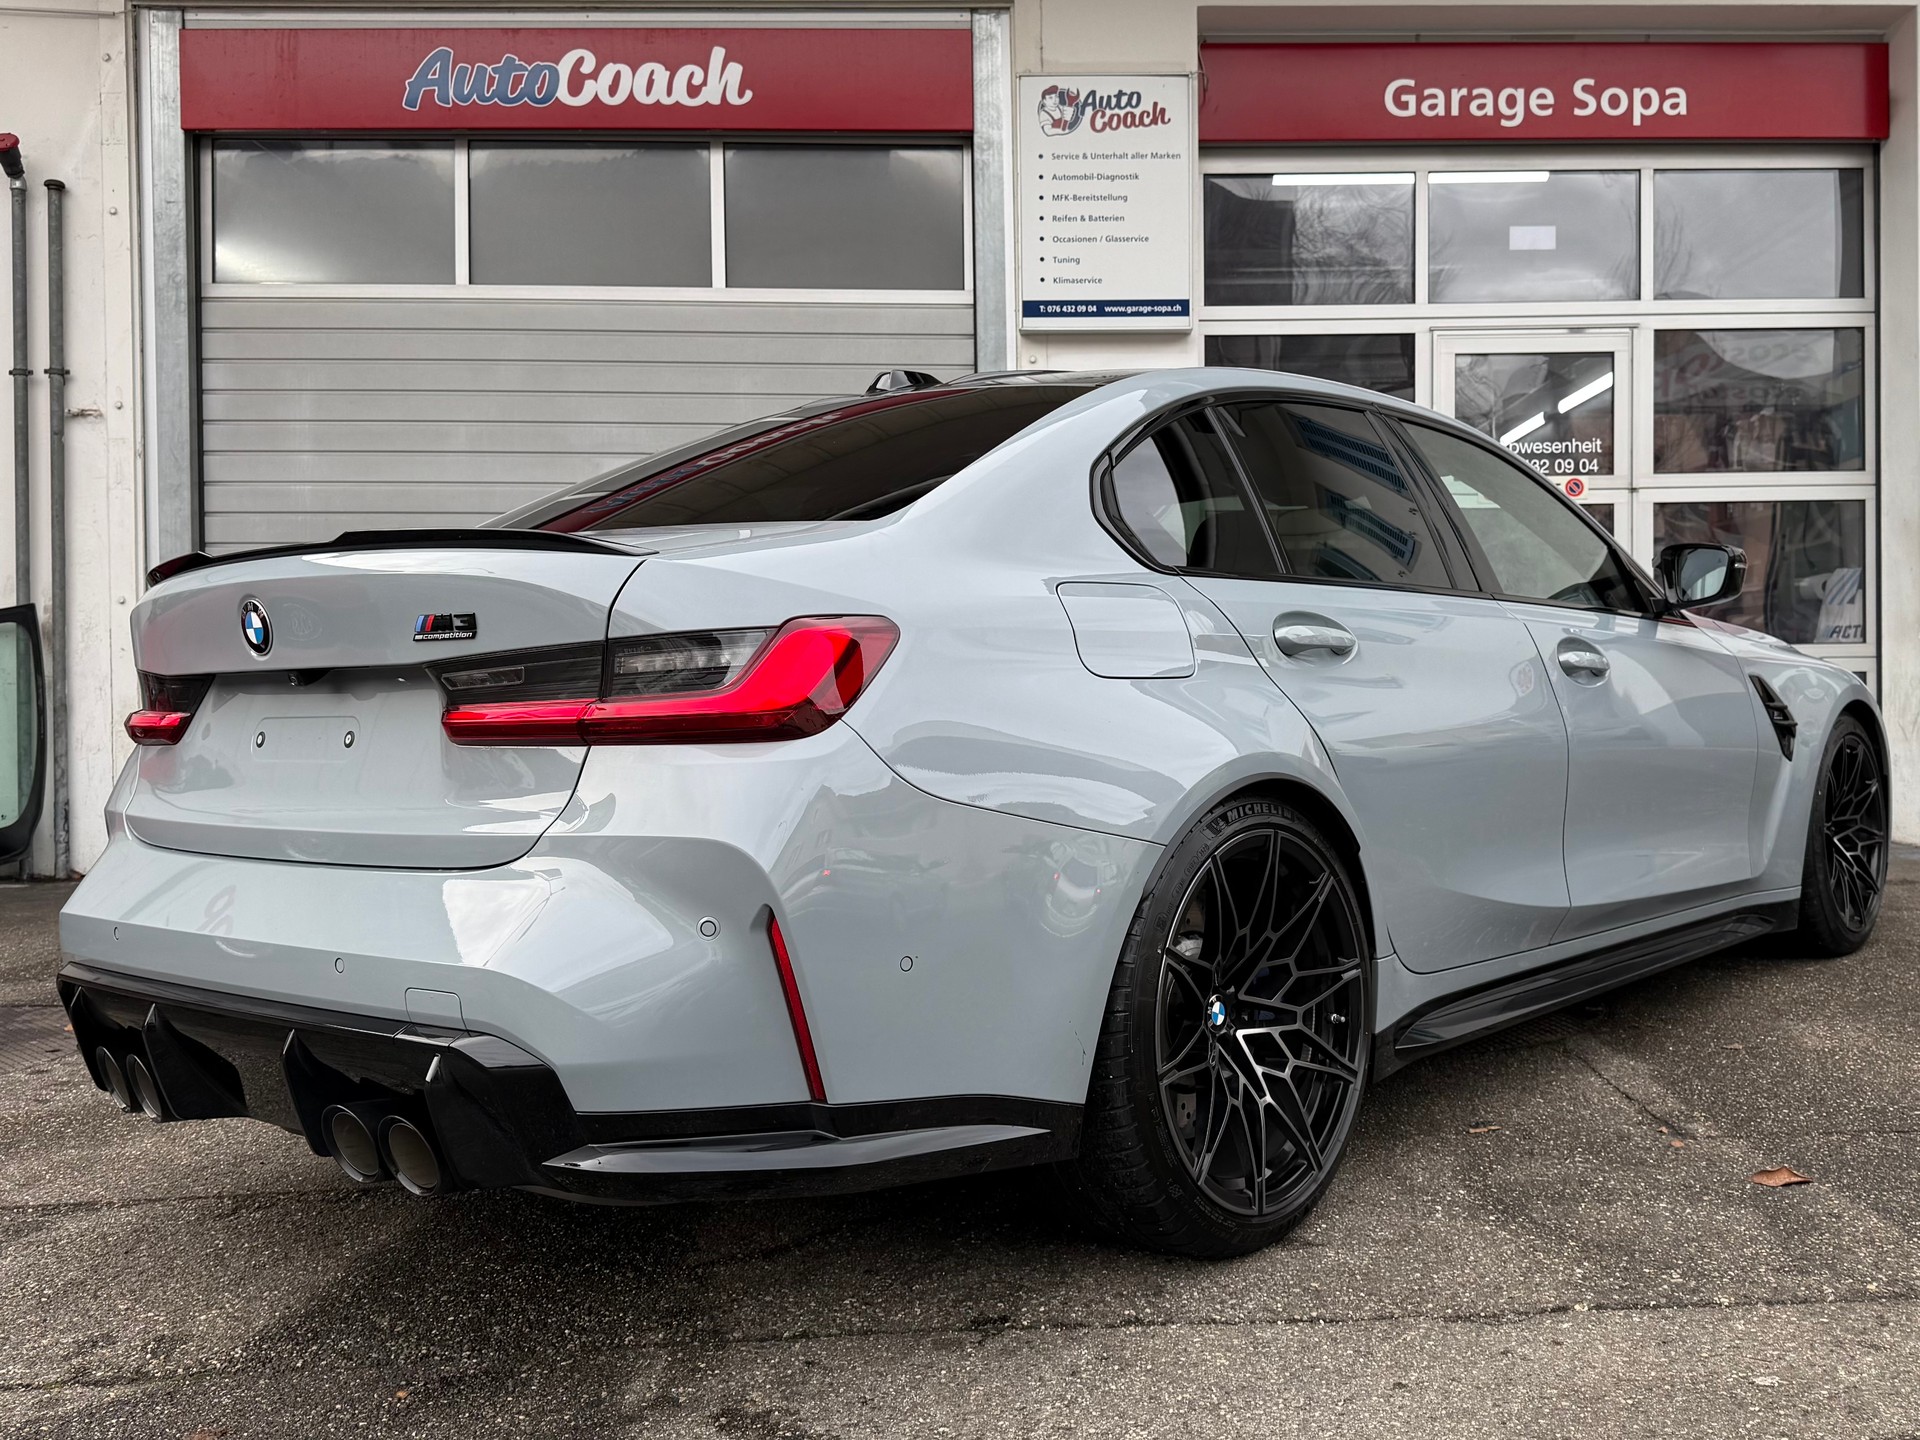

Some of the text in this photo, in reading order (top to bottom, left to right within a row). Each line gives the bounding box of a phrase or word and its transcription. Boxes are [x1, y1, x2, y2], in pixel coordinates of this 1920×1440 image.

[1080, 90, 1142, 117] Auto
[1384, 78, 1688, 127] Garage Sopa
[1090, 101, 1171, 133] Coach
[1051, 151, 1181, 160] Service & Unterhalt aller Marken
[1051, 173, 1140, 182] Automobil-Diagnostik
[1051, 193, 1128, 203] MFK-Bereitstellung
[1052, 215, 1078, 223] Reifen
[1088, 214, 1125, 222] Batterien
[1052, 234, 1149, 244] Occasionen / Glasservice
[1052, 256, 1081, 265] Tuning
[1053, 275, 1103, 284] Klimaservice
[1039, 304, 1182, 314] T: 076 432 09 04 www.garage-sopa.ch
[1524, 459, 1599, 474] 32 09 04
[422, 631, 474, 641] competition
[1226, 803, 1294, 823] MICHELIN
